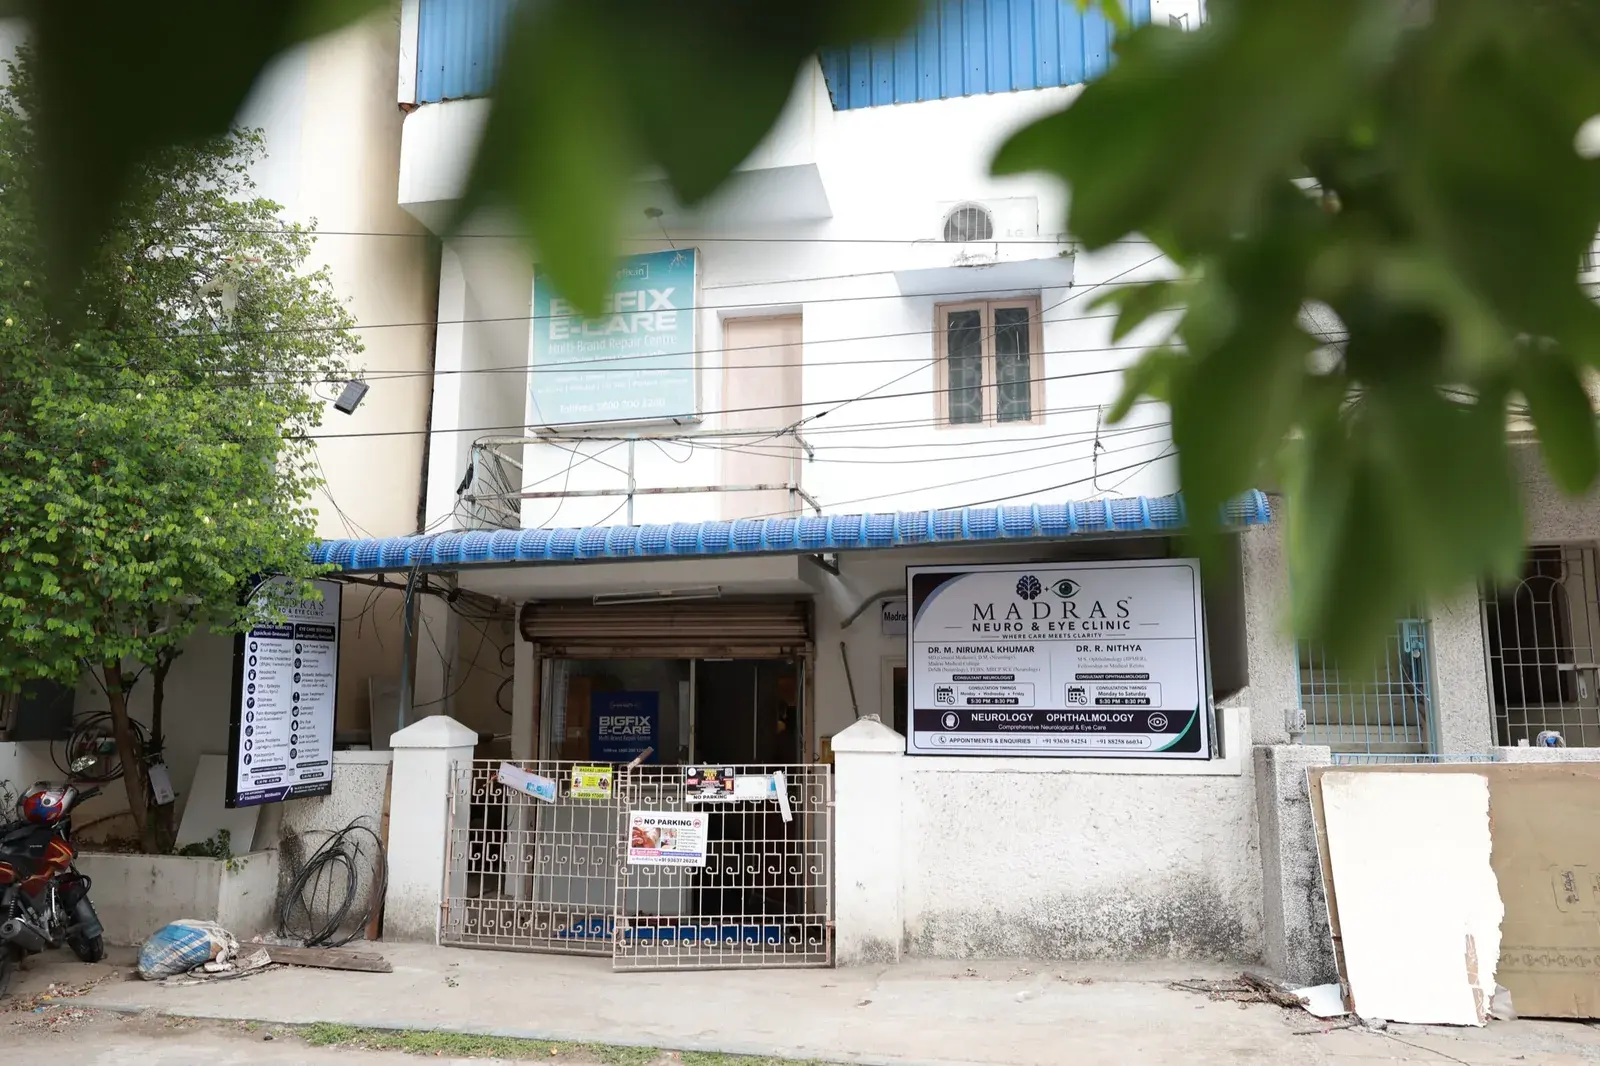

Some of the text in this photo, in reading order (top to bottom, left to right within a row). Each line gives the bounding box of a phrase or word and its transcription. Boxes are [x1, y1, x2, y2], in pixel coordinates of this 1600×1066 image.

[550, 287, 676, 318] BFIX
[549, 310, 677, 340] E-CARE
[609, 337, 641, 350] Repair
[643, 334, 677, 347] Centre
[972, 600, 1130, 621] MADRAS
[884, 611, 908, 621] Madra
[972, 620, 1131, 632] NEURO & EYE CLINIC
[956, 646, 994, 654] NIRUMAL
[997, 645, 1035, 653] KHUMAR
[1076, 645, 1092, 653] DR.
[1106, 644, 1142, 652] NITHYA
[599, 716, 651, 726] BIGFIX
[971, 713, 1134, 722] NEUROLOGY OPHTHALMOLOGY
[599, 726, 651, 735] E-CARE
[658, 818, 692, 826] PARKING
